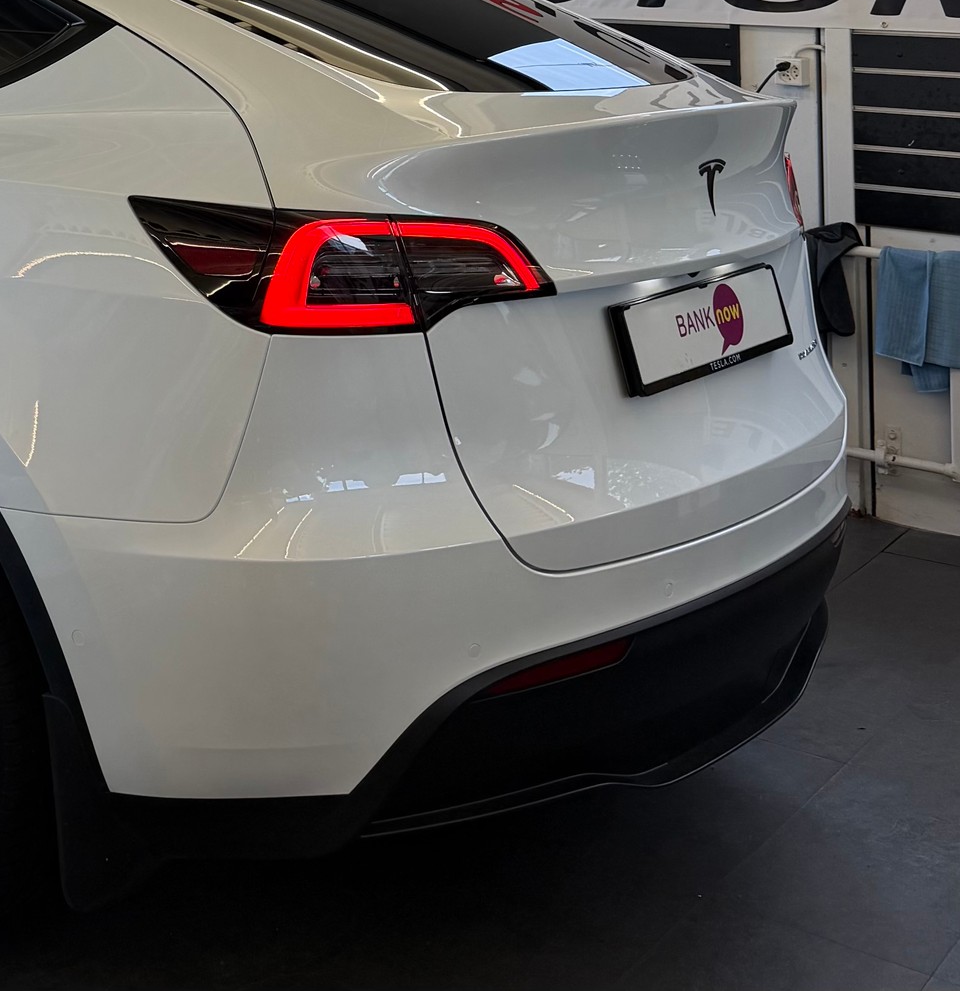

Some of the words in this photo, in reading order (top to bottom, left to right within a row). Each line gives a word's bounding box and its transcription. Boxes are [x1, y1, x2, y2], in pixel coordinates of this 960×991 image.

[675, 306, 716, 338] BANK
[715, 303, 741, 325] now
[709, 353, 742, 371] TESLA.COM
